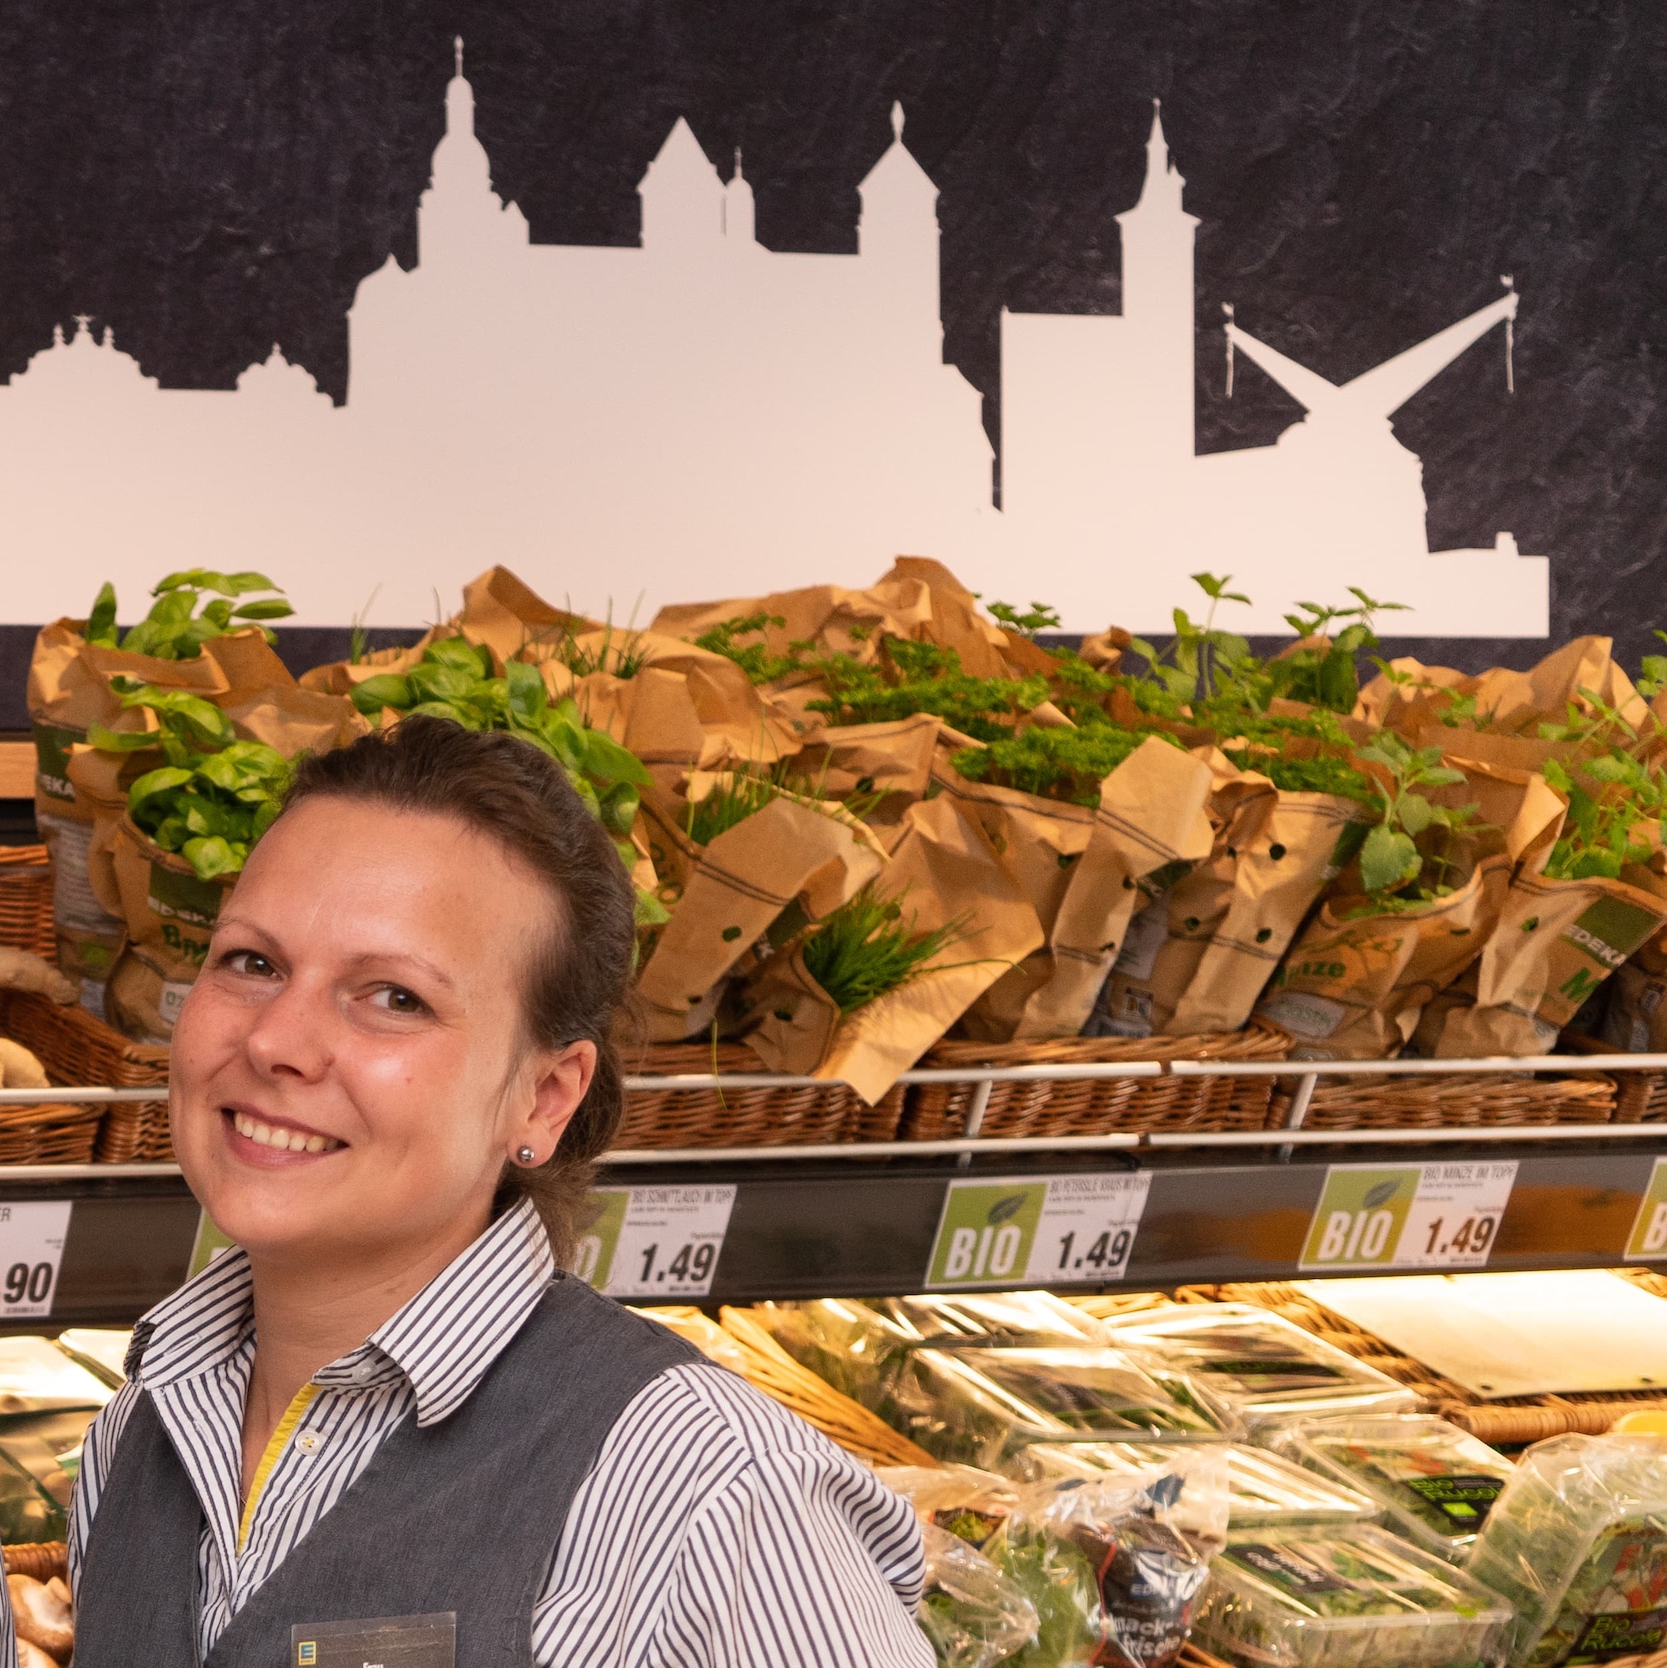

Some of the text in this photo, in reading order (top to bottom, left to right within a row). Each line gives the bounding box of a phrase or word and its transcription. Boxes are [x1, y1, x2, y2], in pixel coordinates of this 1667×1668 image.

[944, 1225, 1022, 1279] BIO
[1058, 1229, 1132, 1269] 1.49
[1317, 1210, 1394, 1261] BIO
[1426, 1215, 1495, 1254] 1.49
[641, 1243, 716, 1282] 1.49
